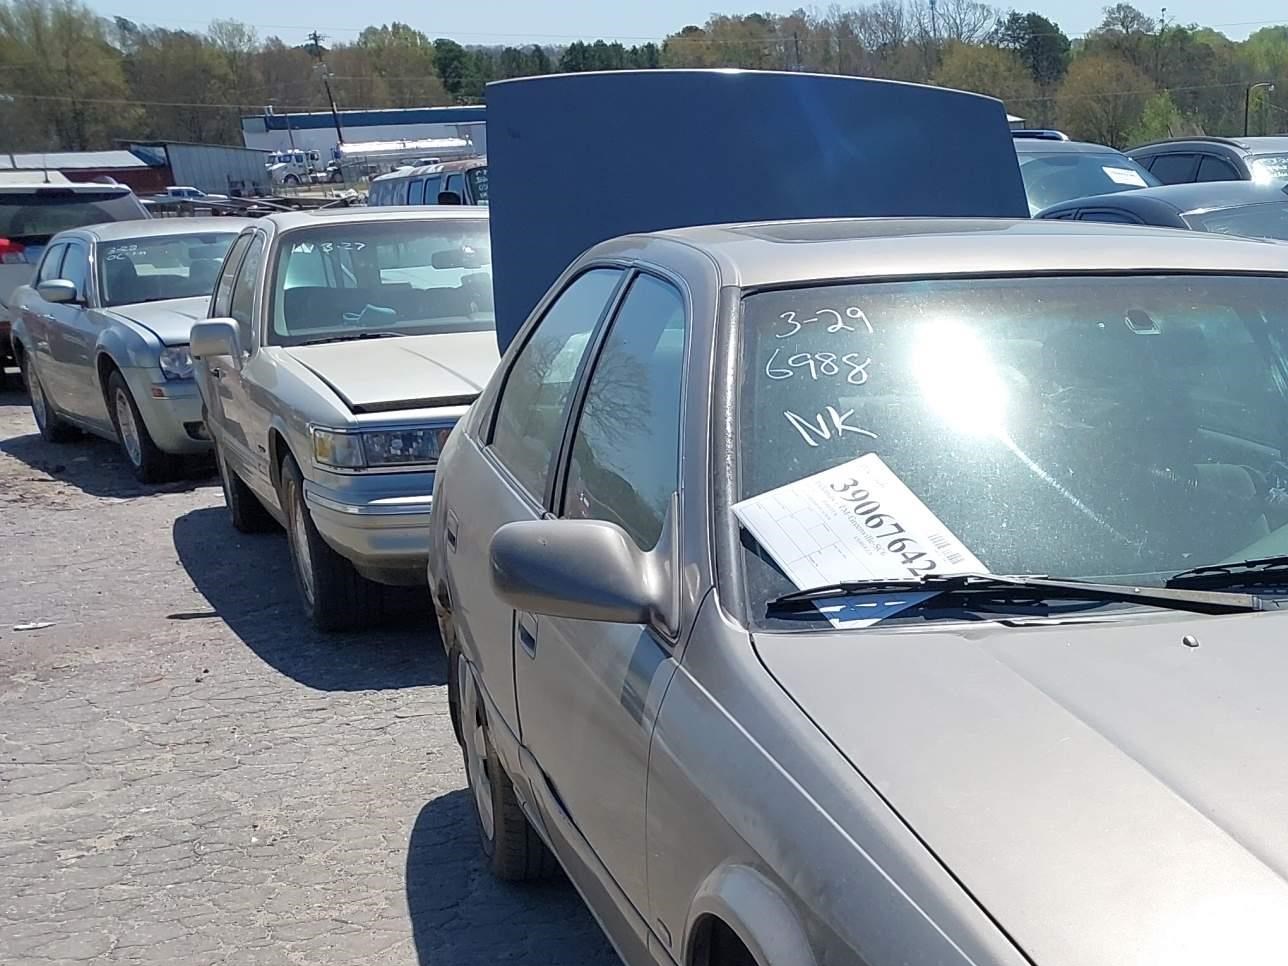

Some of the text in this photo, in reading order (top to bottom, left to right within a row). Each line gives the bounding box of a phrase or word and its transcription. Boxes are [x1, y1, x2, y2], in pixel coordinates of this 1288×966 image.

[776, 307, 874, 339] 3-29
[766, 344, 873, 385] 6988
[784, 406, 880, 447] NK
[830, 477, 938, 577] 39067642
